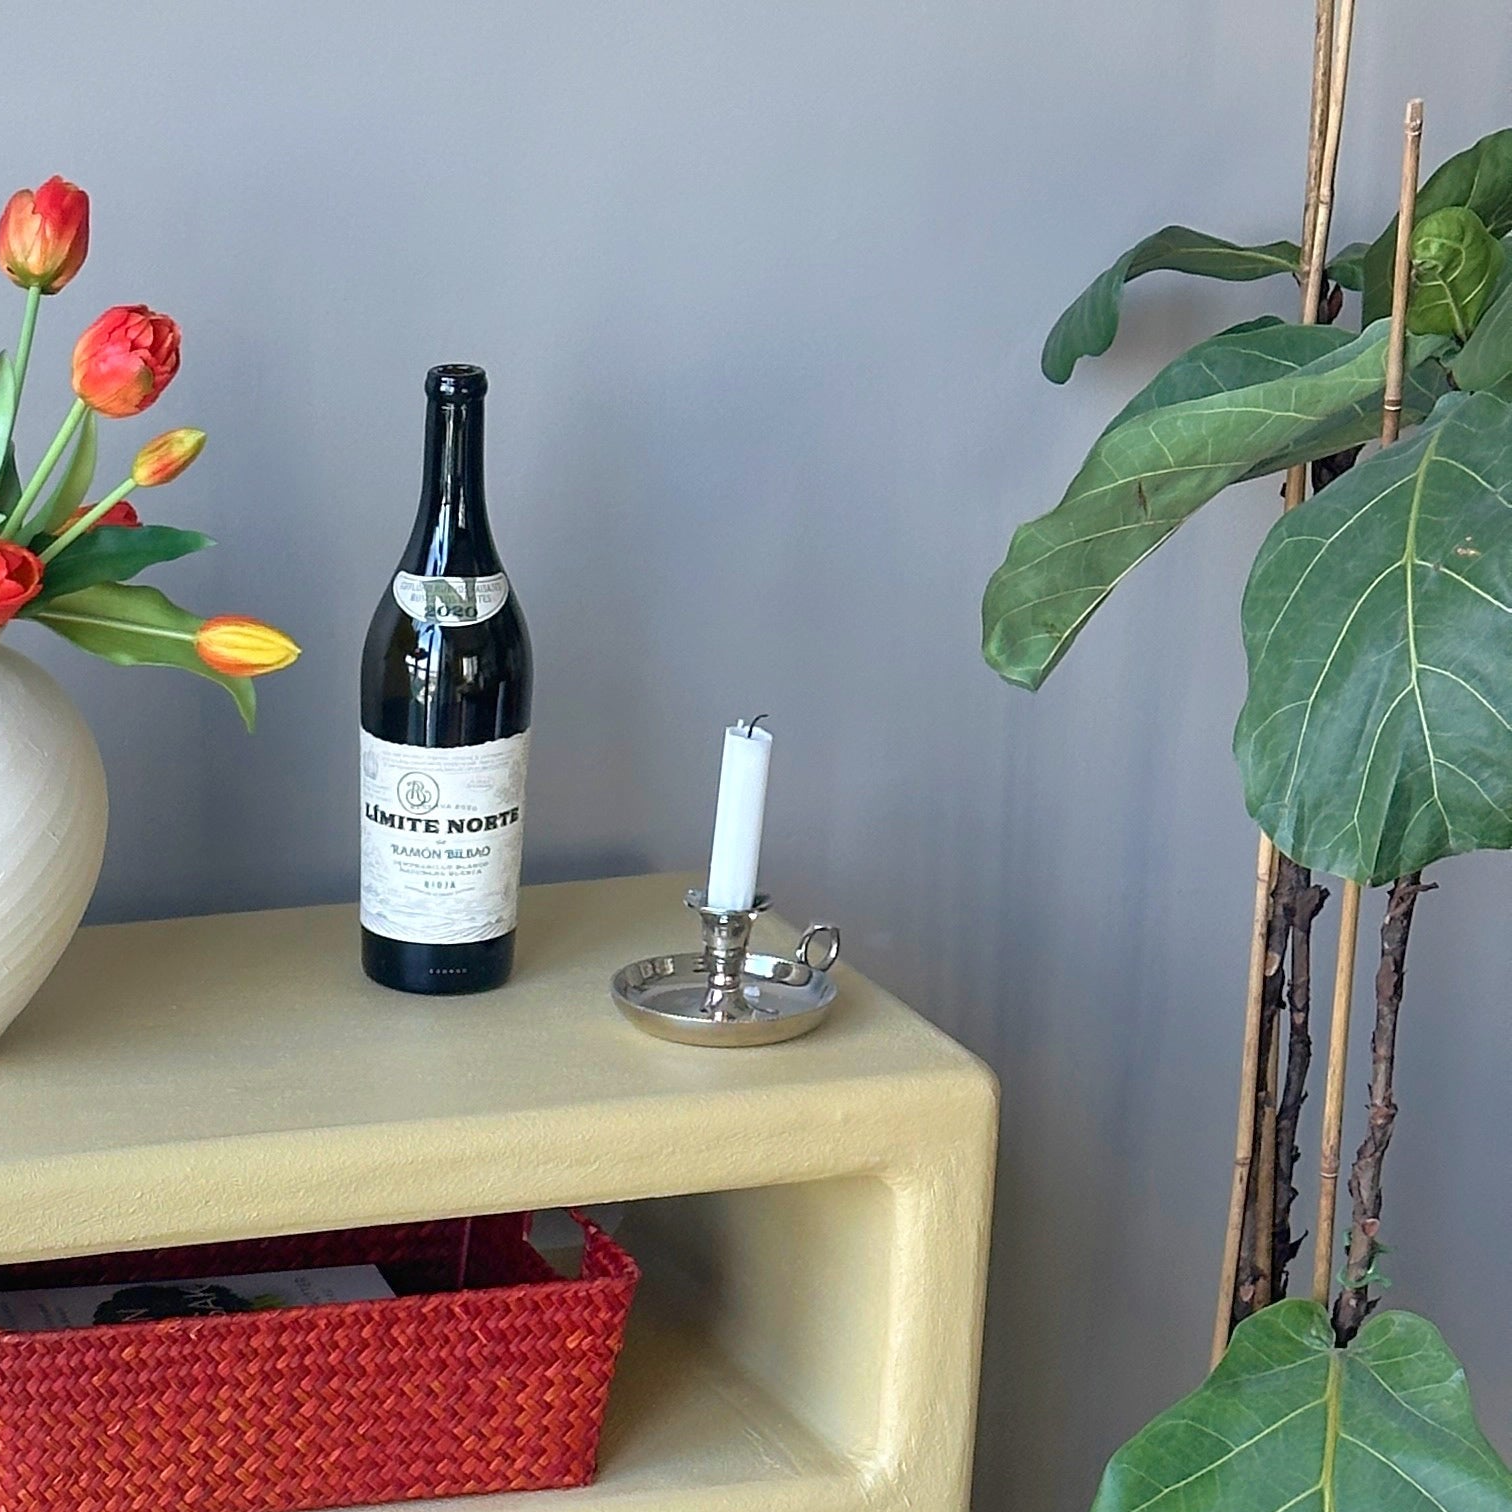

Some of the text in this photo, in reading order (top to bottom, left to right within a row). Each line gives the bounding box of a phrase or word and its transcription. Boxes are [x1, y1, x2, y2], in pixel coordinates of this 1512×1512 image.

[424, 605, 477, 618] 2020
[365, 802, 519, 834] LÍMITE NORTE
[391, 843, 491, 859] RAMÓN BILBAO
